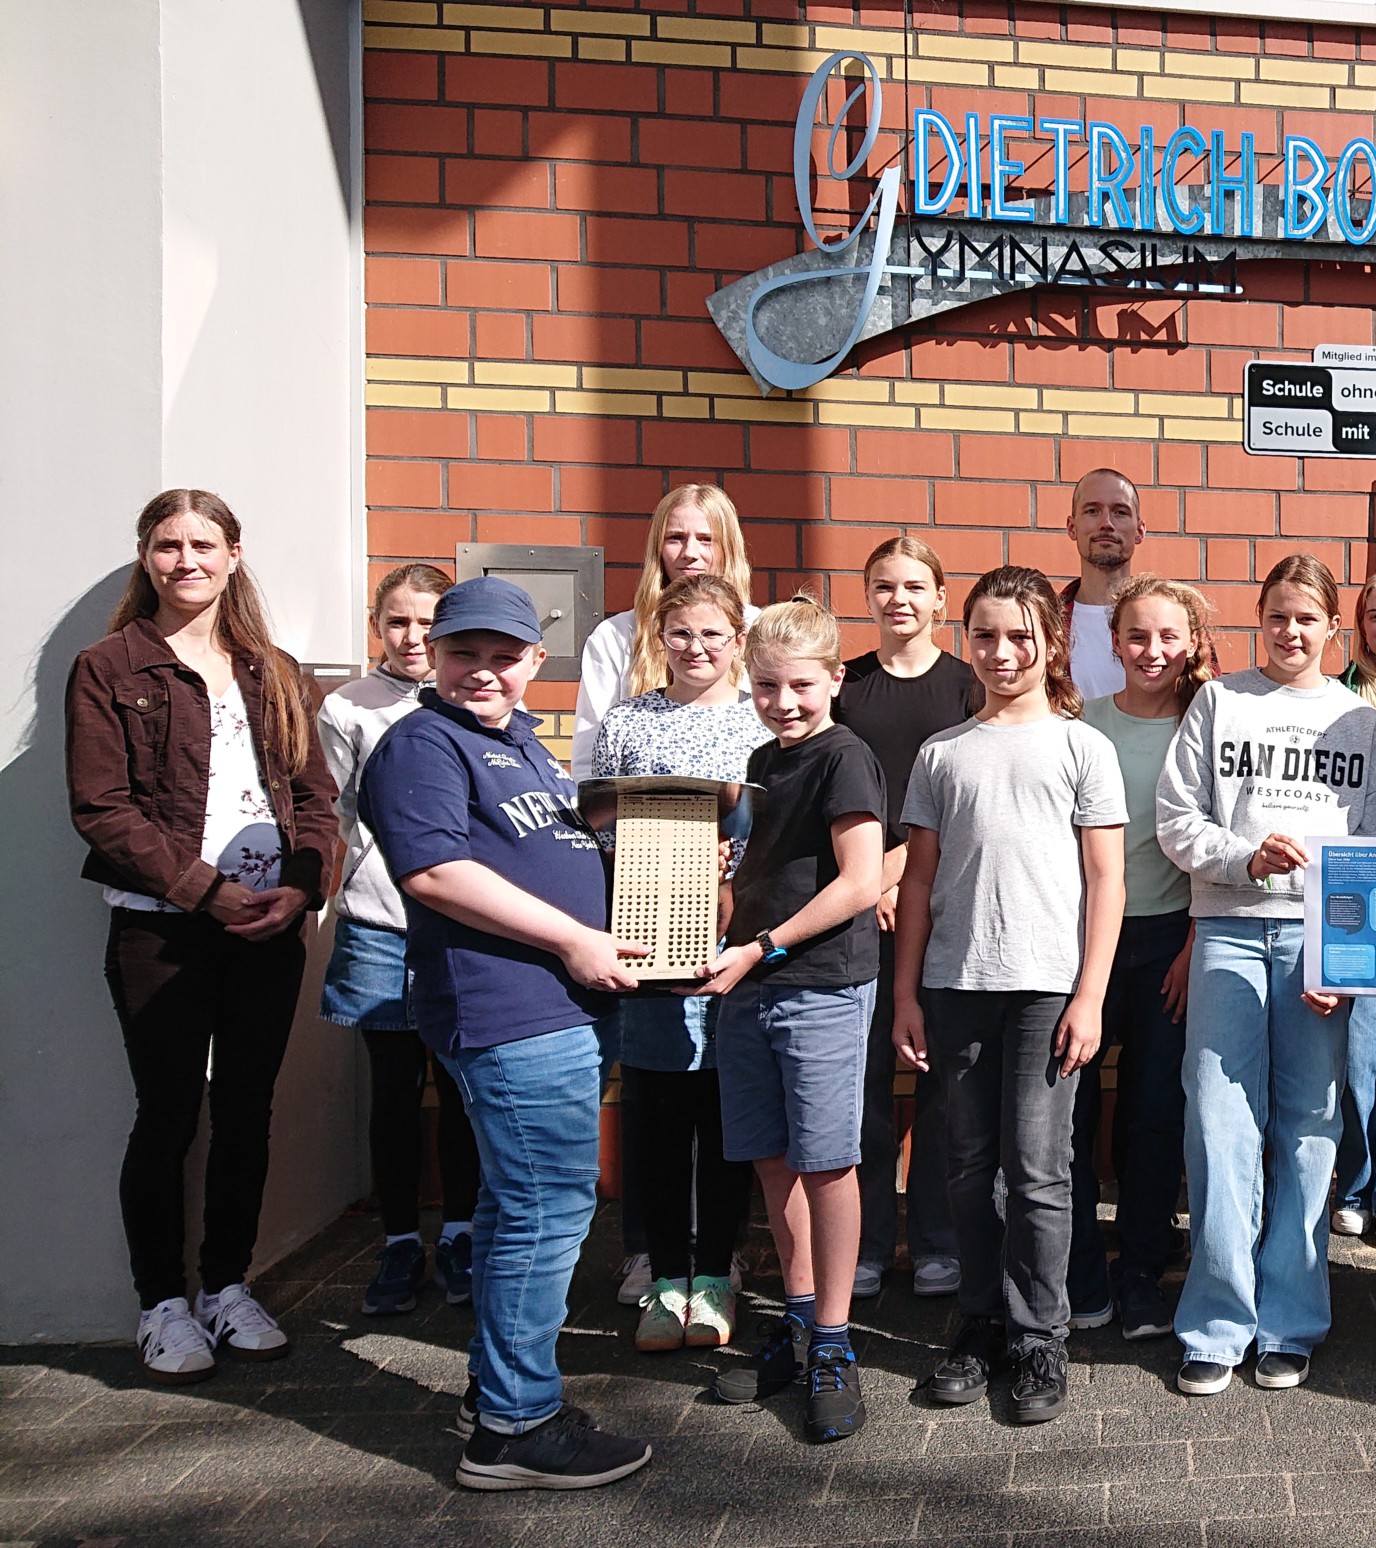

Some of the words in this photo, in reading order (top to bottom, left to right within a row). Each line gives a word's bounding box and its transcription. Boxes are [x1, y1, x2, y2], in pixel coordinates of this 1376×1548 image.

[913, 108, 1254, 237] DIETRICH
[1321, 350, 1362, 363] Mitglied
[1364, 352, 1376, 363] im
[1261, 379, 1324, 398] Schule
[1262, 420, 1323, 438] Schule
[1341, 423, 1370, 440] mit
[1265, 725, 1305, 734] ATHLETIC
[1219, 740, 1275, 782] SAN
[1281, 746, 1365, 789] DIEGO
[1246, 785, 1331, 804] WESTCOAST
